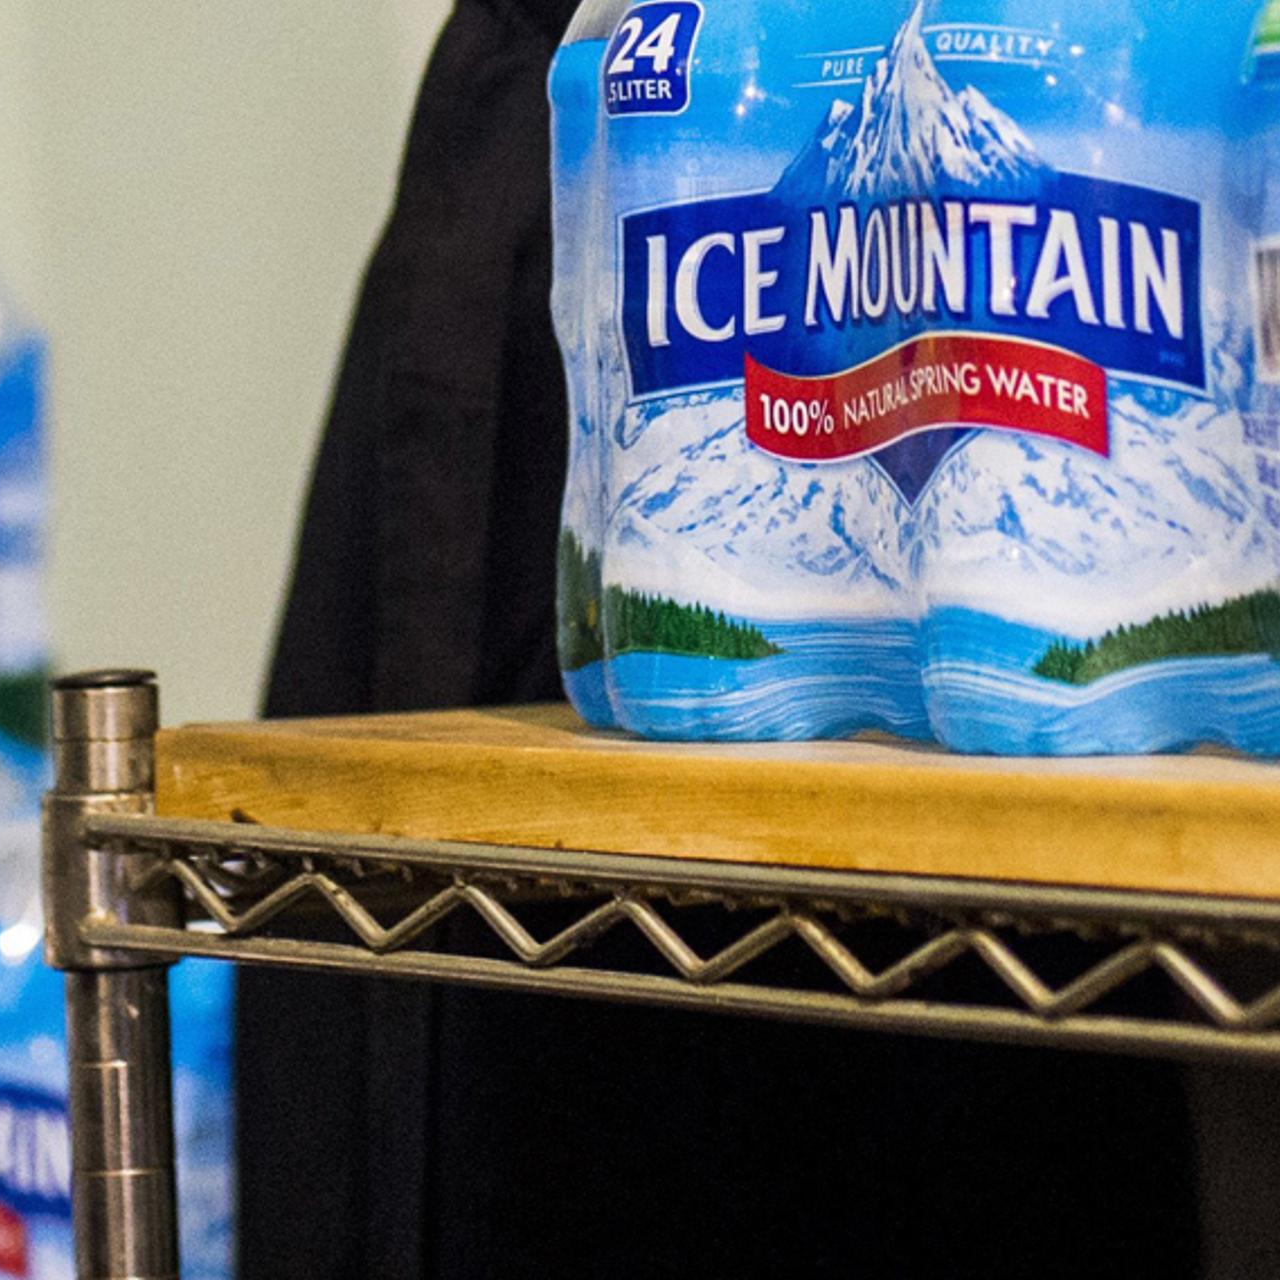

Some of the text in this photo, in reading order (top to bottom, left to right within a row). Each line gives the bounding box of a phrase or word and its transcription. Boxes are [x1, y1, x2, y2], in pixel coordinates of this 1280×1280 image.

[607, 12, 681, 74] 24
[822, 56, 863, 77] PURE
[936, 32, 1054, 56] QUALITY
[646, 201, 1183, 347] ICE MOUNTAIN
[759, 362, 1090, 436] 100% NATURAL SPRING WATER
